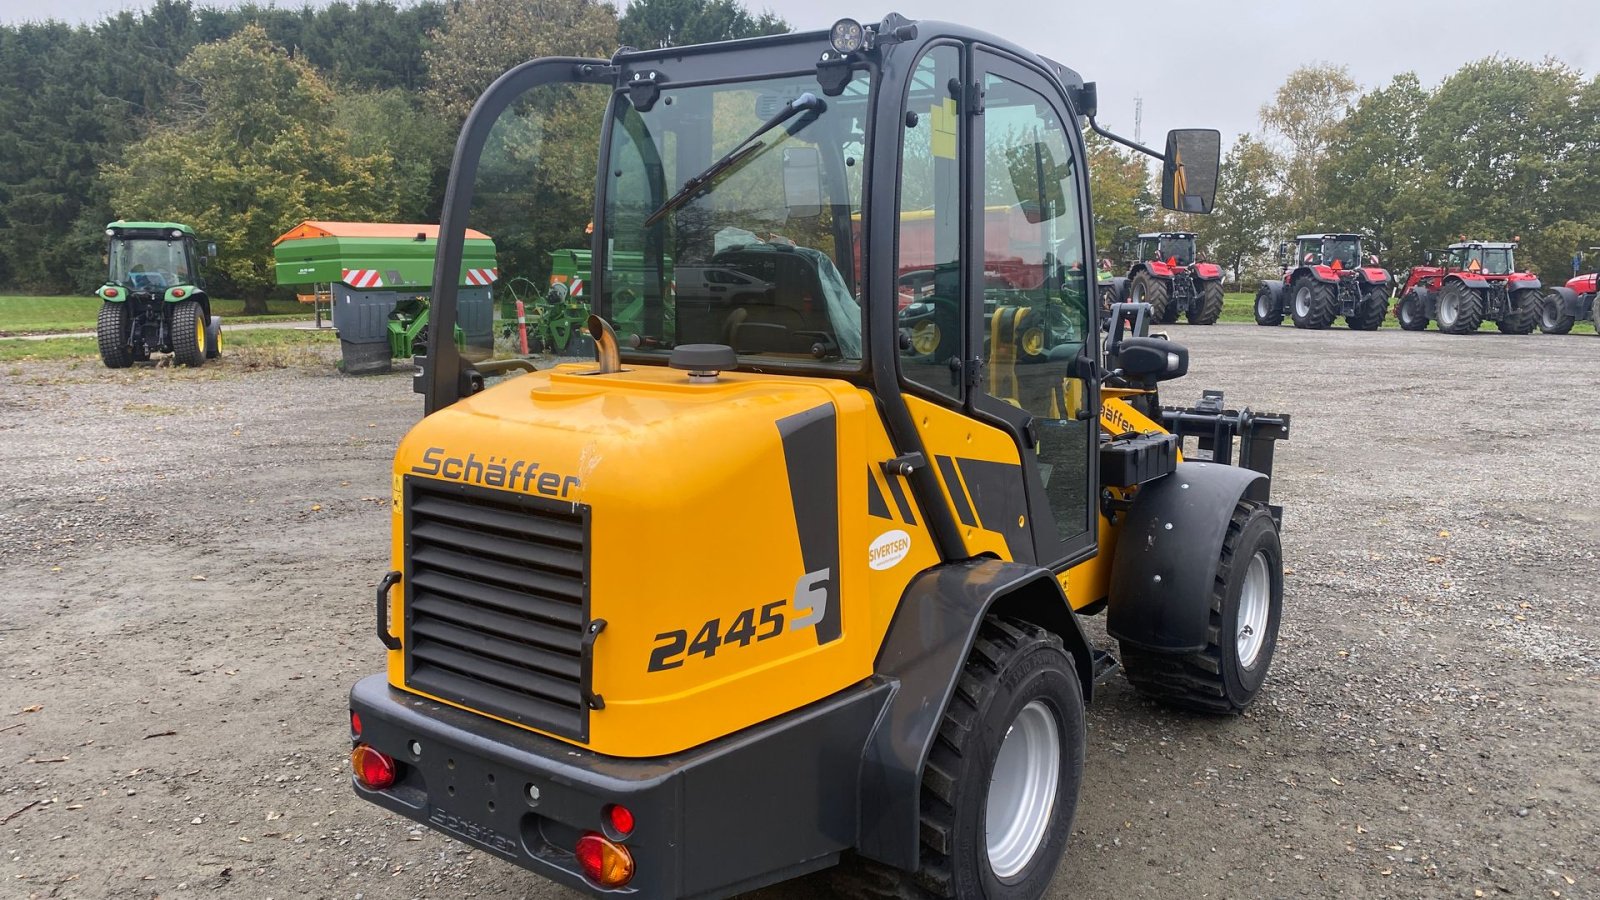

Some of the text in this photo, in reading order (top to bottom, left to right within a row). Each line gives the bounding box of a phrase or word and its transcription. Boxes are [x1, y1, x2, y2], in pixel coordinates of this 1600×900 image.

[412, 447, 580, 497] Schäffer
[869, 536, 908, 562] SIVERTSEN
[647, 567, 830, 672] 2445 S
